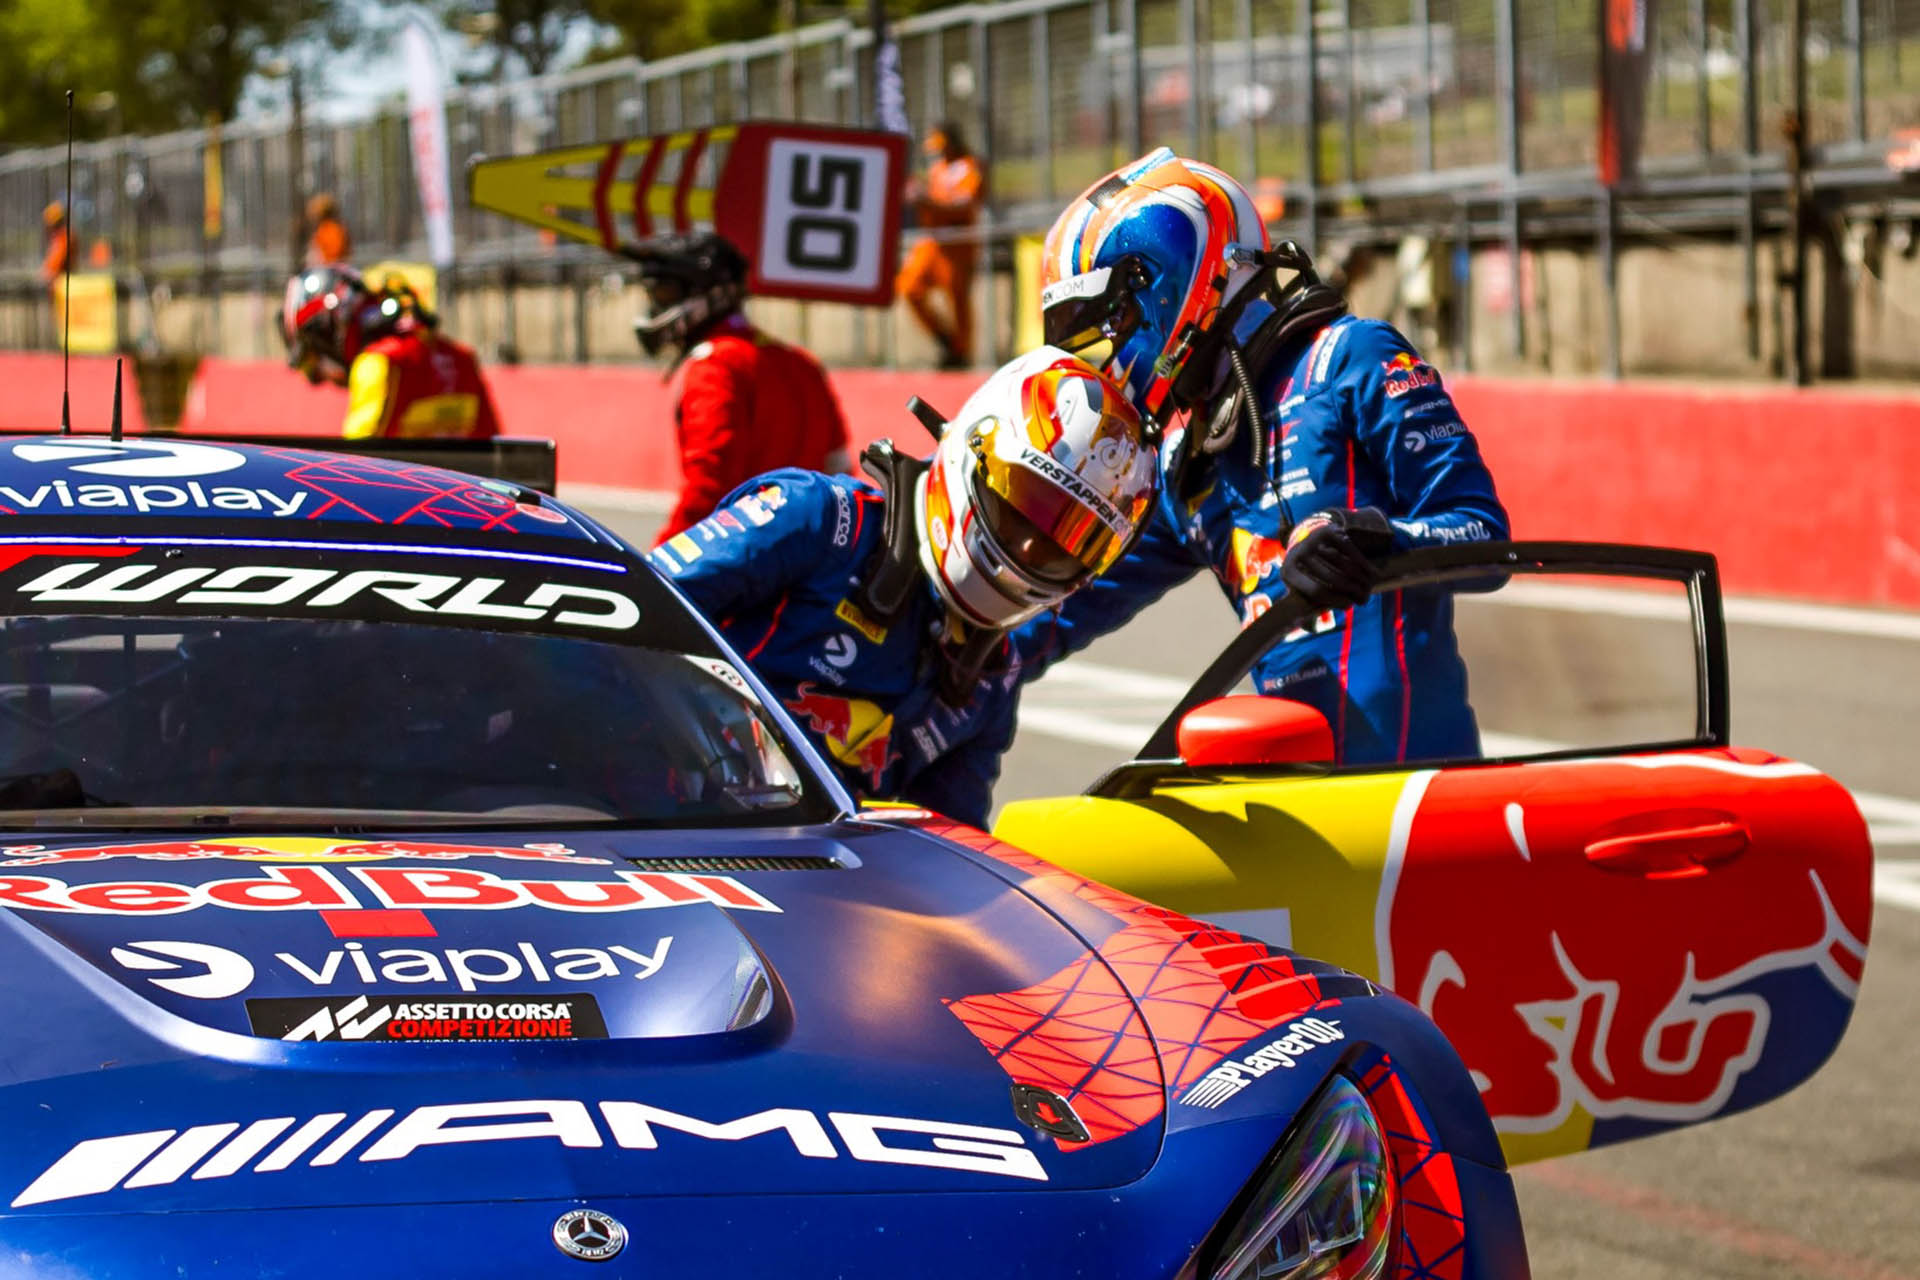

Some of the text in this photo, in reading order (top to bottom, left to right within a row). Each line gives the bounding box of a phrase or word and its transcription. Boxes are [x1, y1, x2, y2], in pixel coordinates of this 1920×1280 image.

[786, 153, 865, 272] 50
[0, 479, 308, 516] viaplay
[16, 562, 640, 630] WORLD
[346, 866, 784, 913] Bull
[273, 935, 674, 992] viaplay
[386, 1020, 573, 1038] COMPETIZIONE
[394, 1003, 571, 1020] ASSETTO CORSA
[358, 1099, 1049, 1181] AMG
